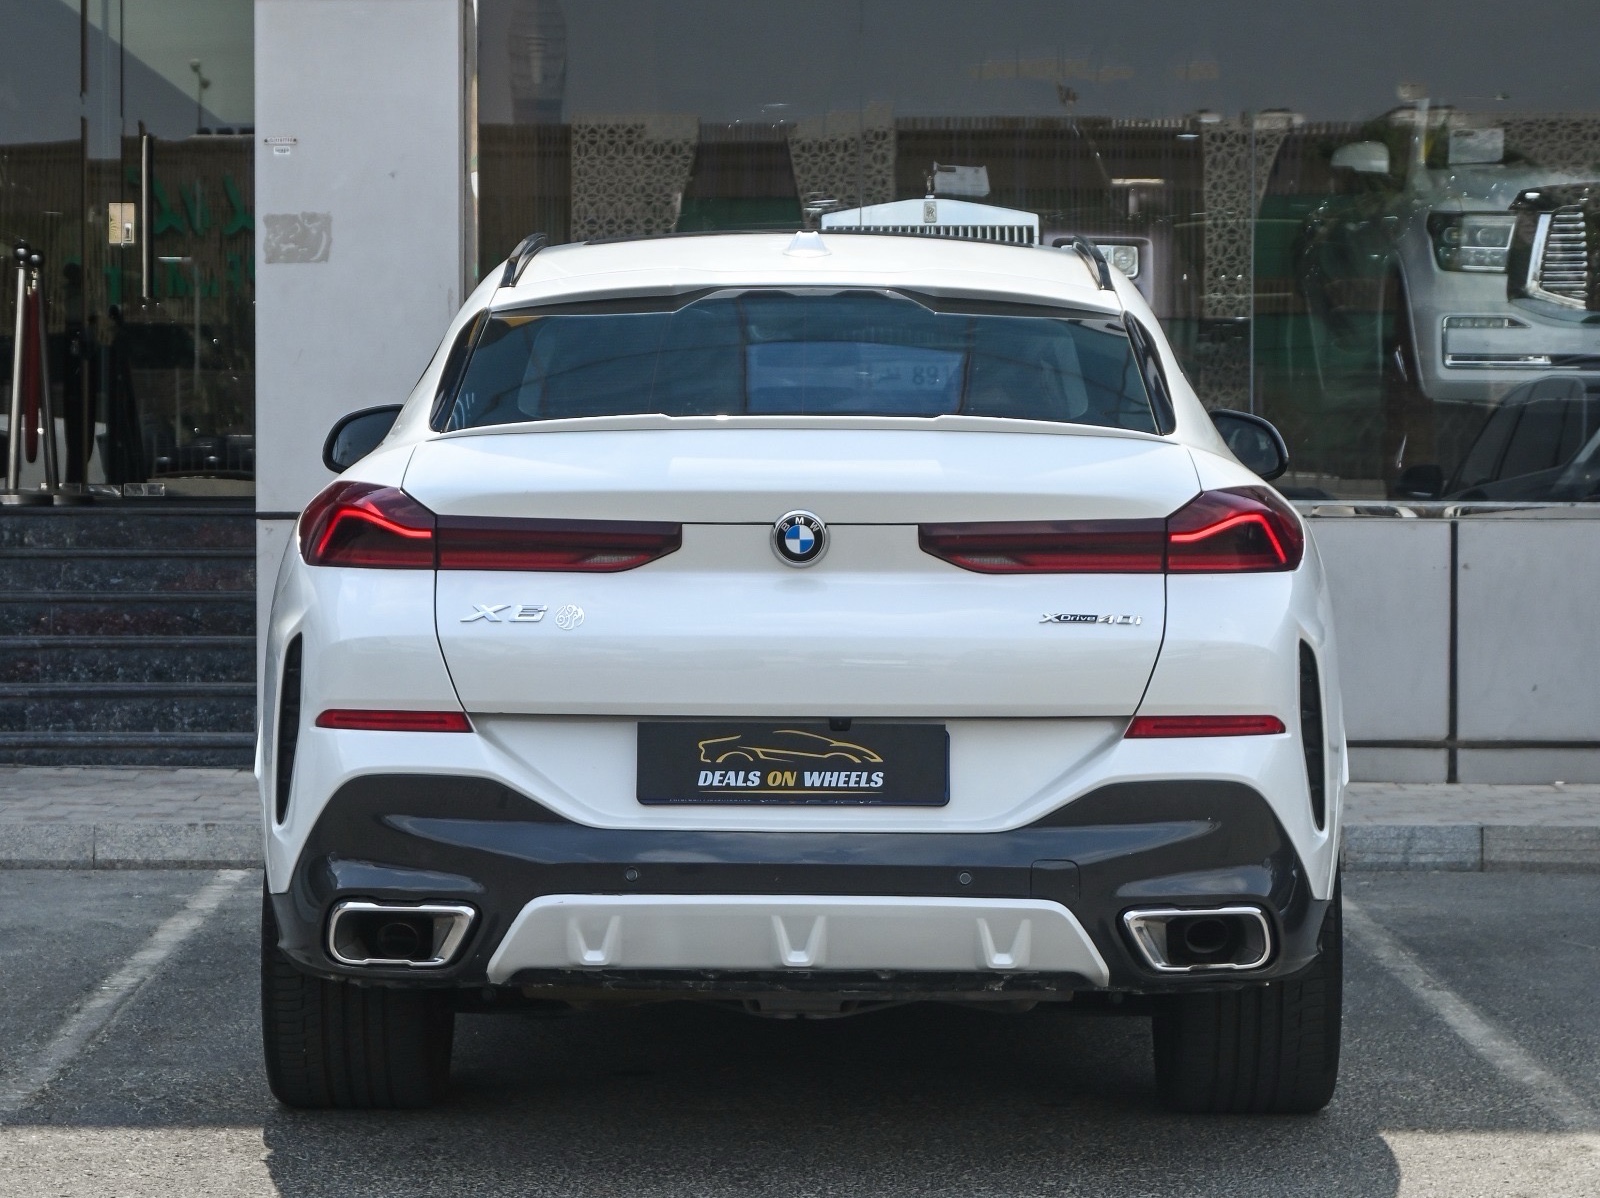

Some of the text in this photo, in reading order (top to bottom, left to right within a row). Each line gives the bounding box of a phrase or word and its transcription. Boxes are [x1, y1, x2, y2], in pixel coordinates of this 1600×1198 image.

[780, 516, 820, 532] BMW
[460, 604, 548, 622] X6
[698, 770, 884, 788] DEALS ON WHEELS
